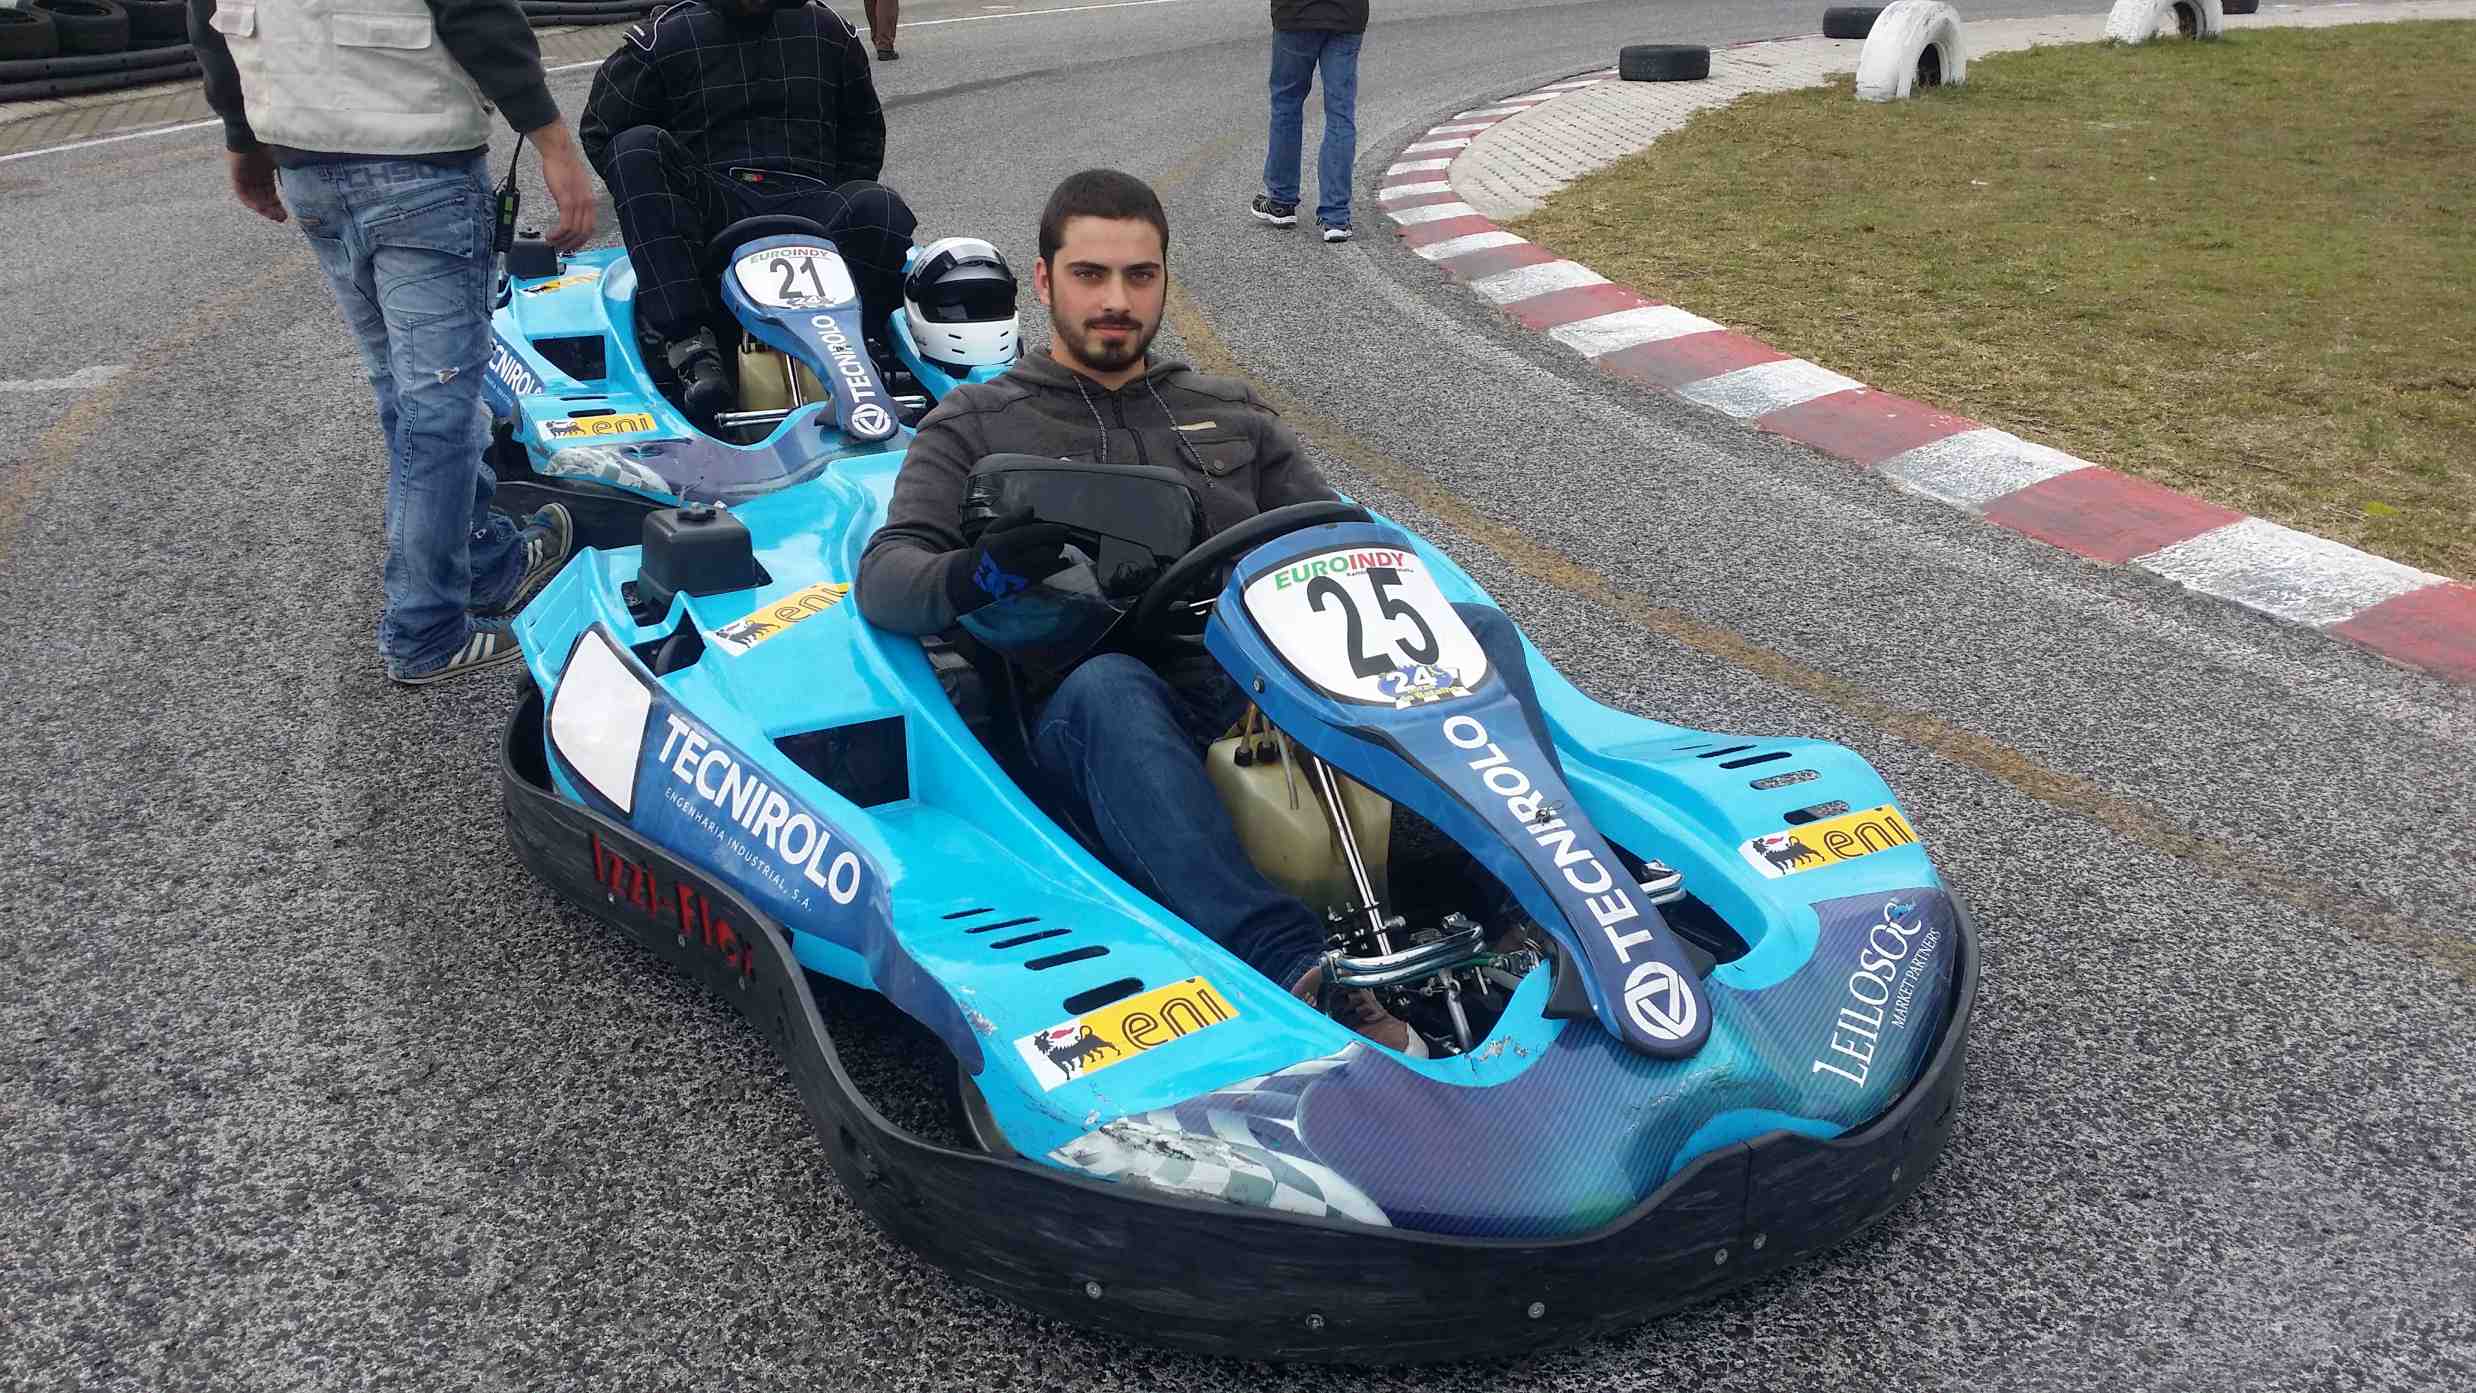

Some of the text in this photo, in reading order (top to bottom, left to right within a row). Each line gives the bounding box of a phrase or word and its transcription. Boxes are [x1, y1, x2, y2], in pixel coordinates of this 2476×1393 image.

[750, 248, 828, 264] EUROINDY
[769, 256, 826, 299] 21
[811, 314, 876, 403] TECNIROLO
[592, 414, 650, 435] eni
[1274, 552, 1404, 591] EUROINDY
[774, 585, 848, 623] eni
[1306, 568, 1440, 679] 25
[657, 713, 862, 905] TECNIROLO
[664, 787, 725, 841] ENGENHARIA
[1823, 807, 1913, 860] eni
[1443, 715, 1655, 964] TECNIROLO
[1891, 926, 1942, 1030] MARKET PARTNERS
[1121, 978, 1229, 1051] eni
